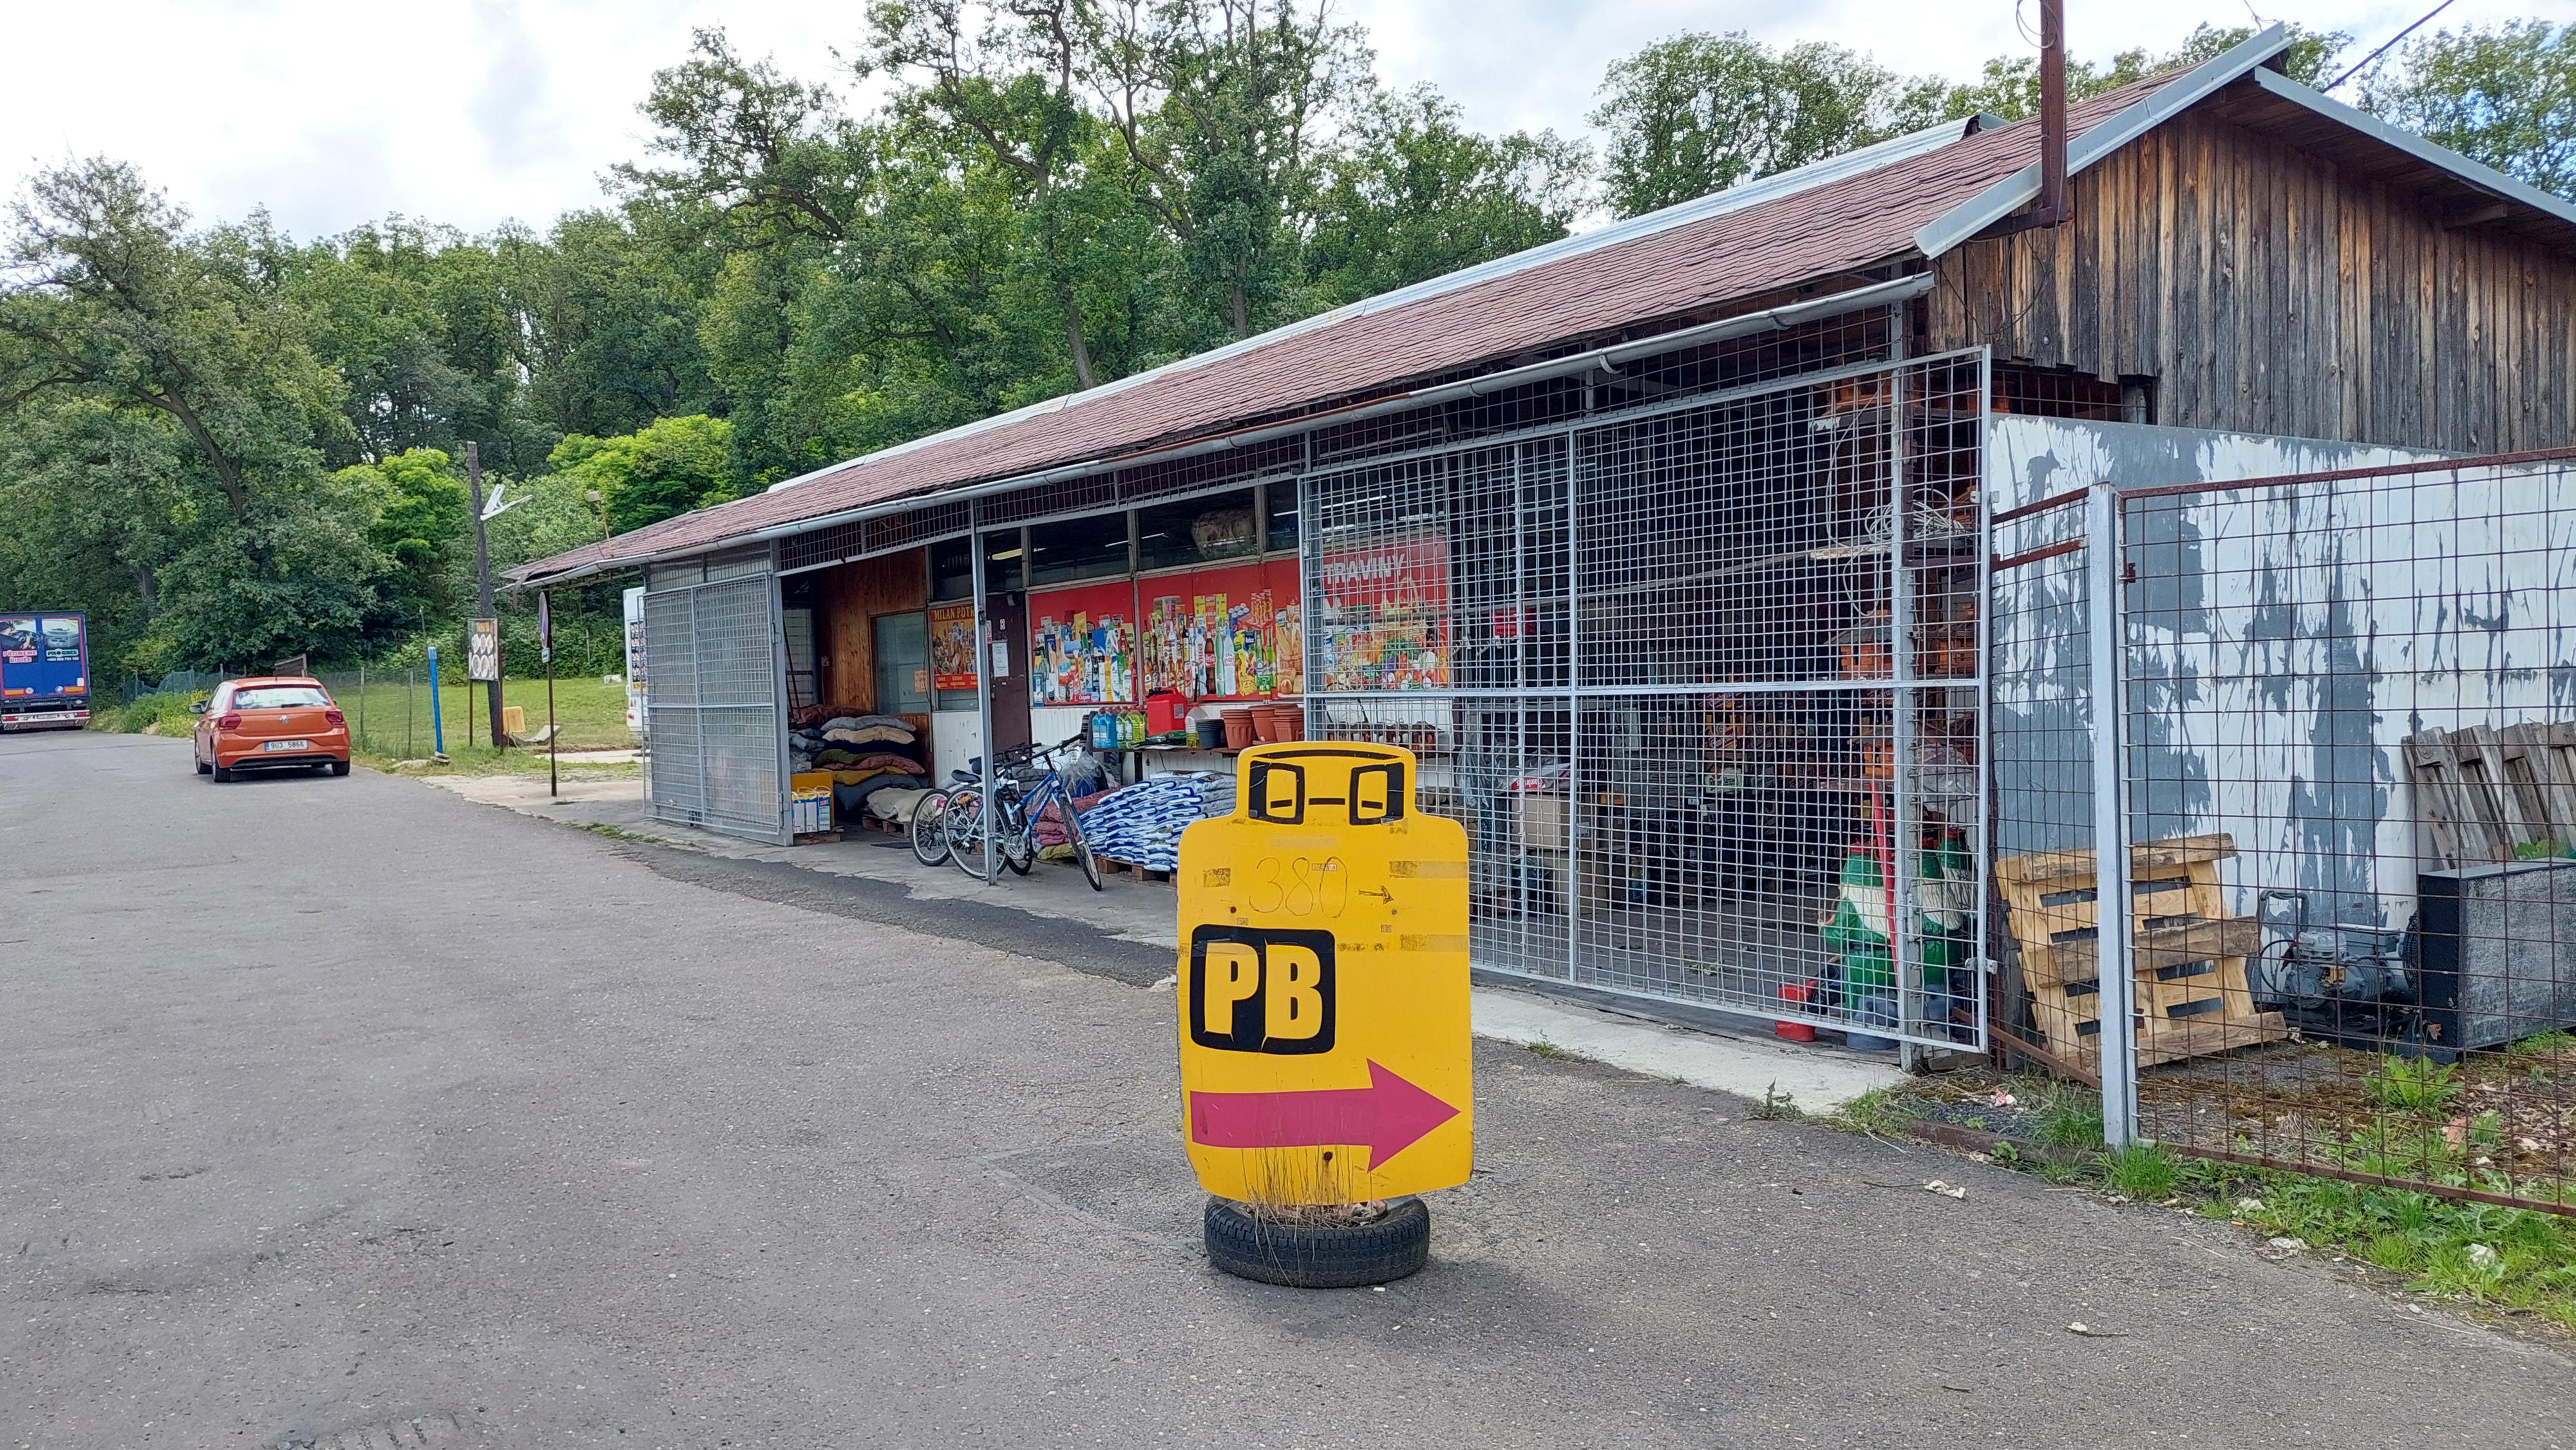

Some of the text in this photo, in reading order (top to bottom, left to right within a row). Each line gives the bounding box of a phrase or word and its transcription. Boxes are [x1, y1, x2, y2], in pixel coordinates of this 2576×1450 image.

[934, 607, 955, 620] MILAN
[1249, 856, 1349, 919] 380
[1204, 942, 1323, 1040] PB
